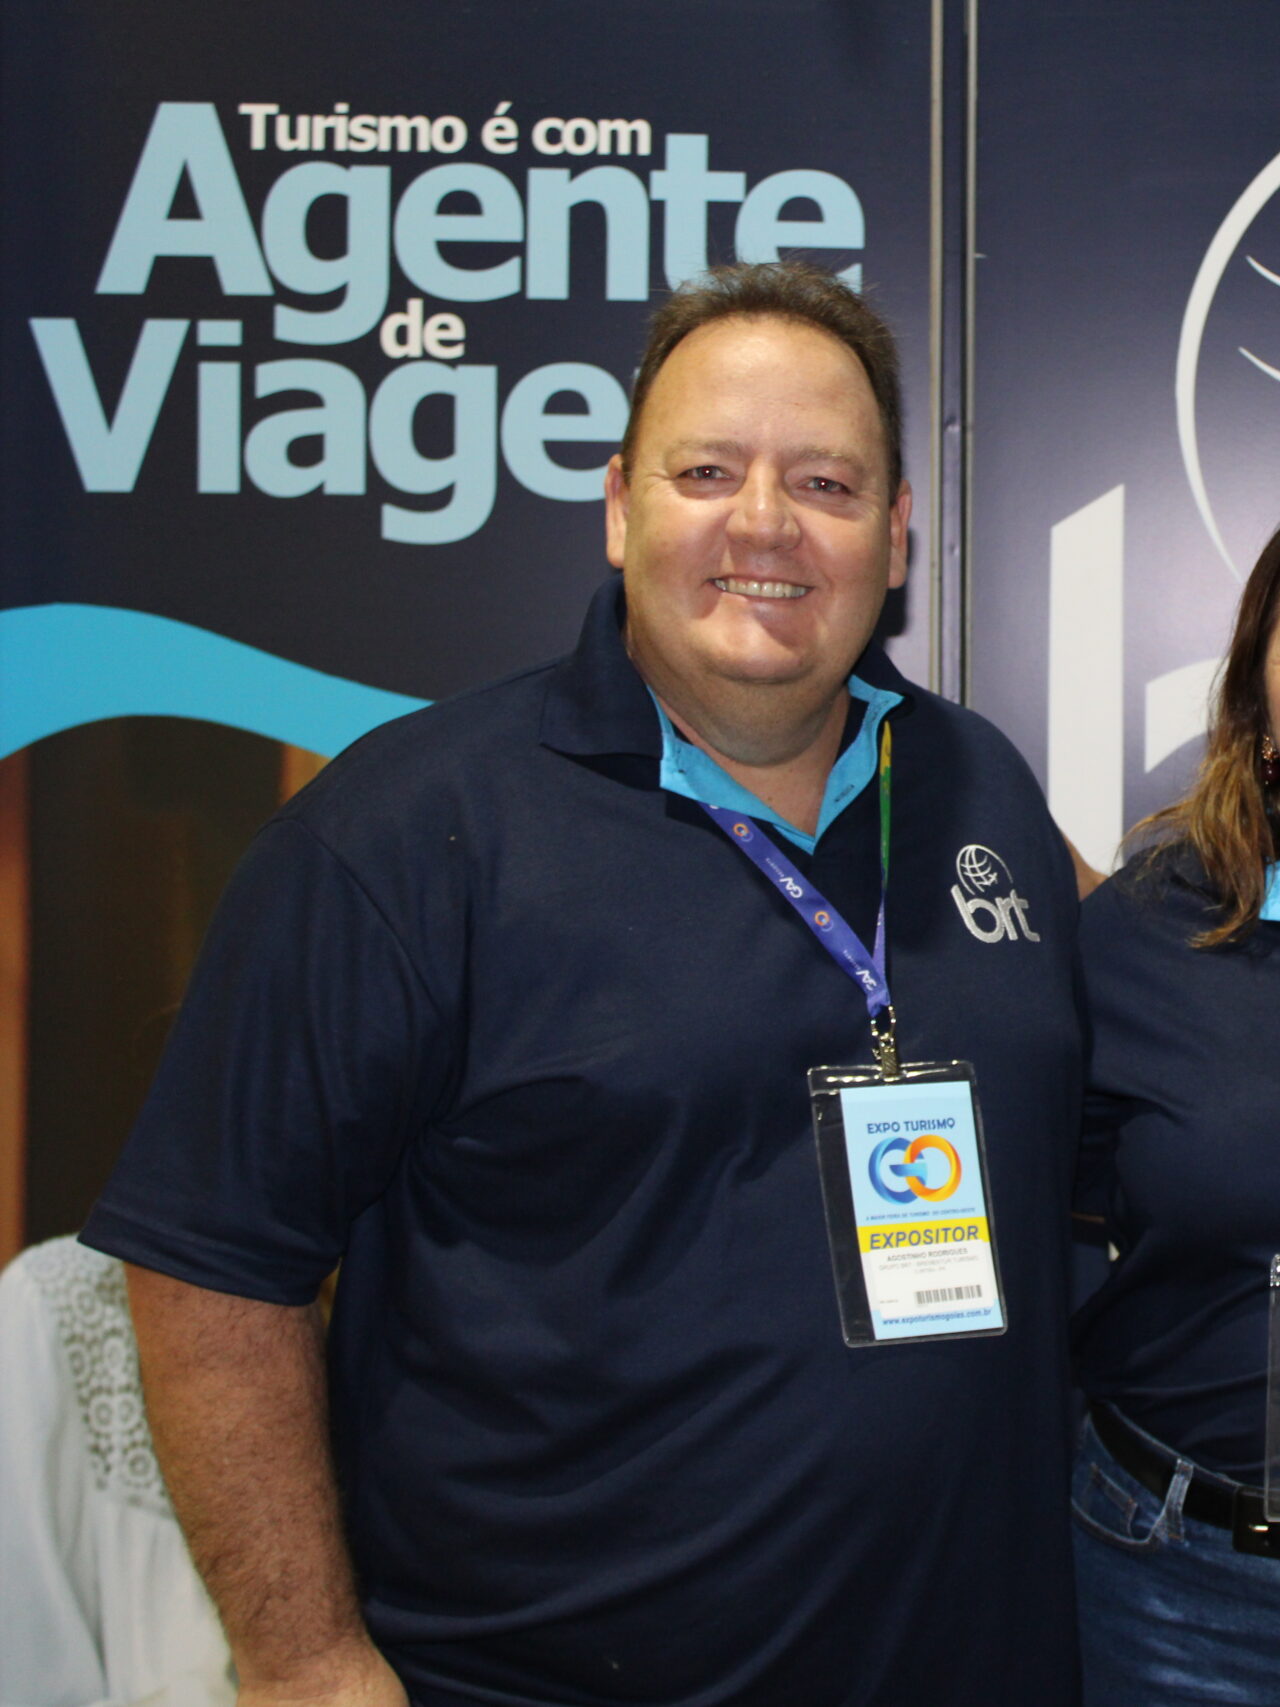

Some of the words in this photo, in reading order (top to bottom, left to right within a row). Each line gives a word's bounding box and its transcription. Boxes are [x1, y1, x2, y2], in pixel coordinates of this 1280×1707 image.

[237, 102, 468, 153] Turismo
[481, 101, 519, 154] é
[531, 117, 651, 156] com
[95, 101, 866, 345] Agente
[380, 298, 465, 358] de
[28, 317, 634, 544] Viage
[950, 884, 1041, 943] brt
[867, 1120, 900, 1134] EXPO
[903, 1117, 956, 1132] TURISMO
[870, 1225, 979, 1250] EXPOSITOR
